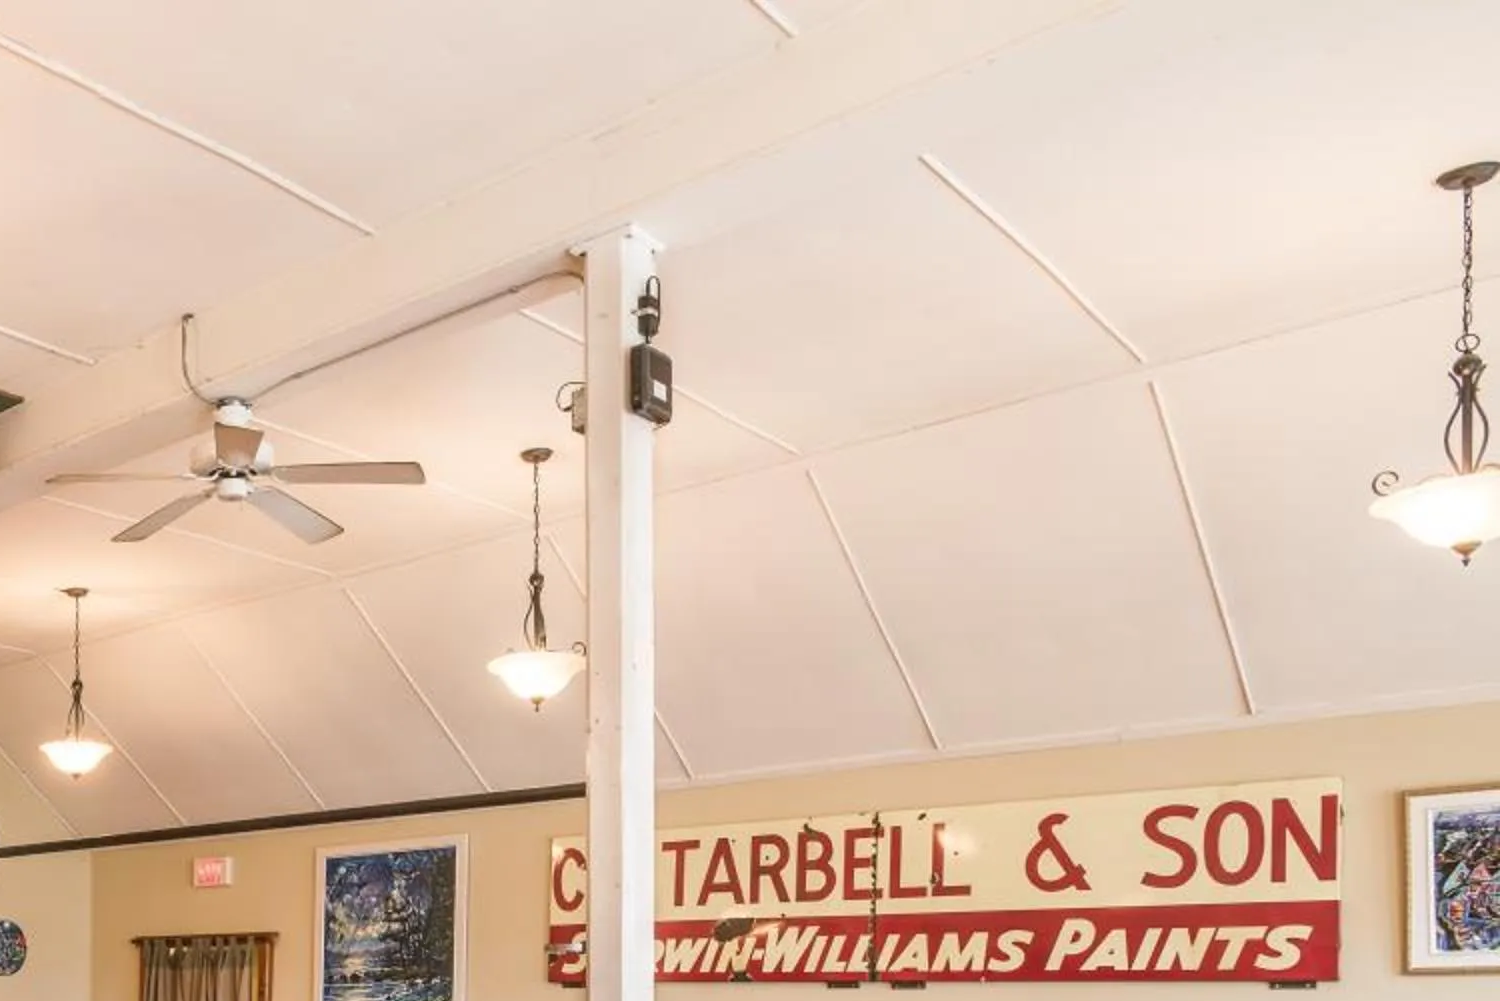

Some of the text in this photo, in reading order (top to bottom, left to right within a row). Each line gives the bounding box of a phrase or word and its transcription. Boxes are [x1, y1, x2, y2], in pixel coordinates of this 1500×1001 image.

[661, 823, 972, 907] TARBELL
[1025, 813, 1092, 893] &
[1140, 795, 1338, 889] SON
